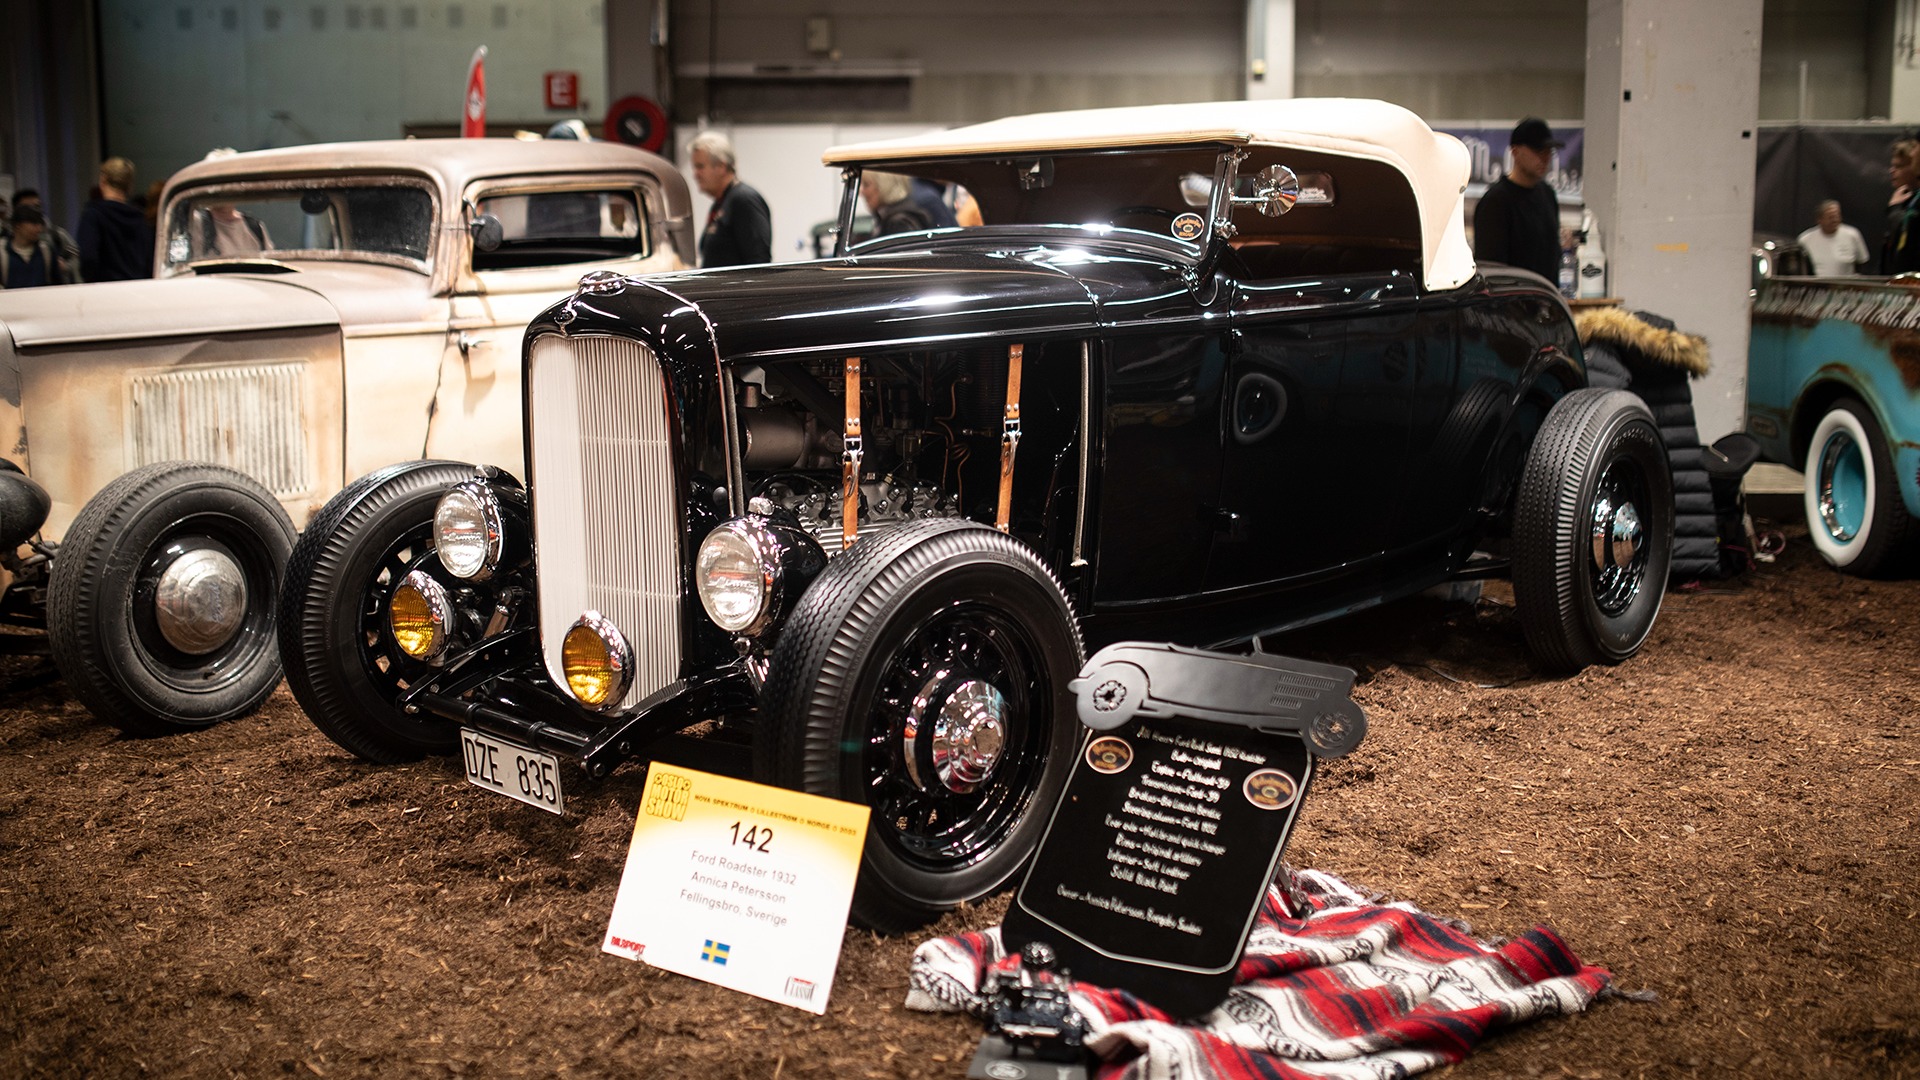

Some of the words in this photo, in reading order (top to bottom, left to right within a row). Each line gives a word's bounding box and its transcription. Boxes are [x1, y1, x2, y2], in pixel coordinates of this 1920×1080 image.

[464, 737, 503, 787] DZE
[517, 755, 556, 804] 835
[662, 773, 684, 789] OSLO
[646, 797, 687, 822] SHOW
[650, 783, 690, 806] MOTOR
[713, 798, 748, 811] SPEKTRUM
[806, 820, 831, 830] NORGE
[731, 821, 773, 853] 142
[691, 850, 716, 866] Ford
[718, 857, 768, 878] Roadster
[772, 870, 797, 885] 1932
[691, 871, 728, 890] Annica
[730, 881, 786, 904] Petersson
[680, 889, 741, 916] Fellingsbro,
[746, 906, 787, 927] Sverige
